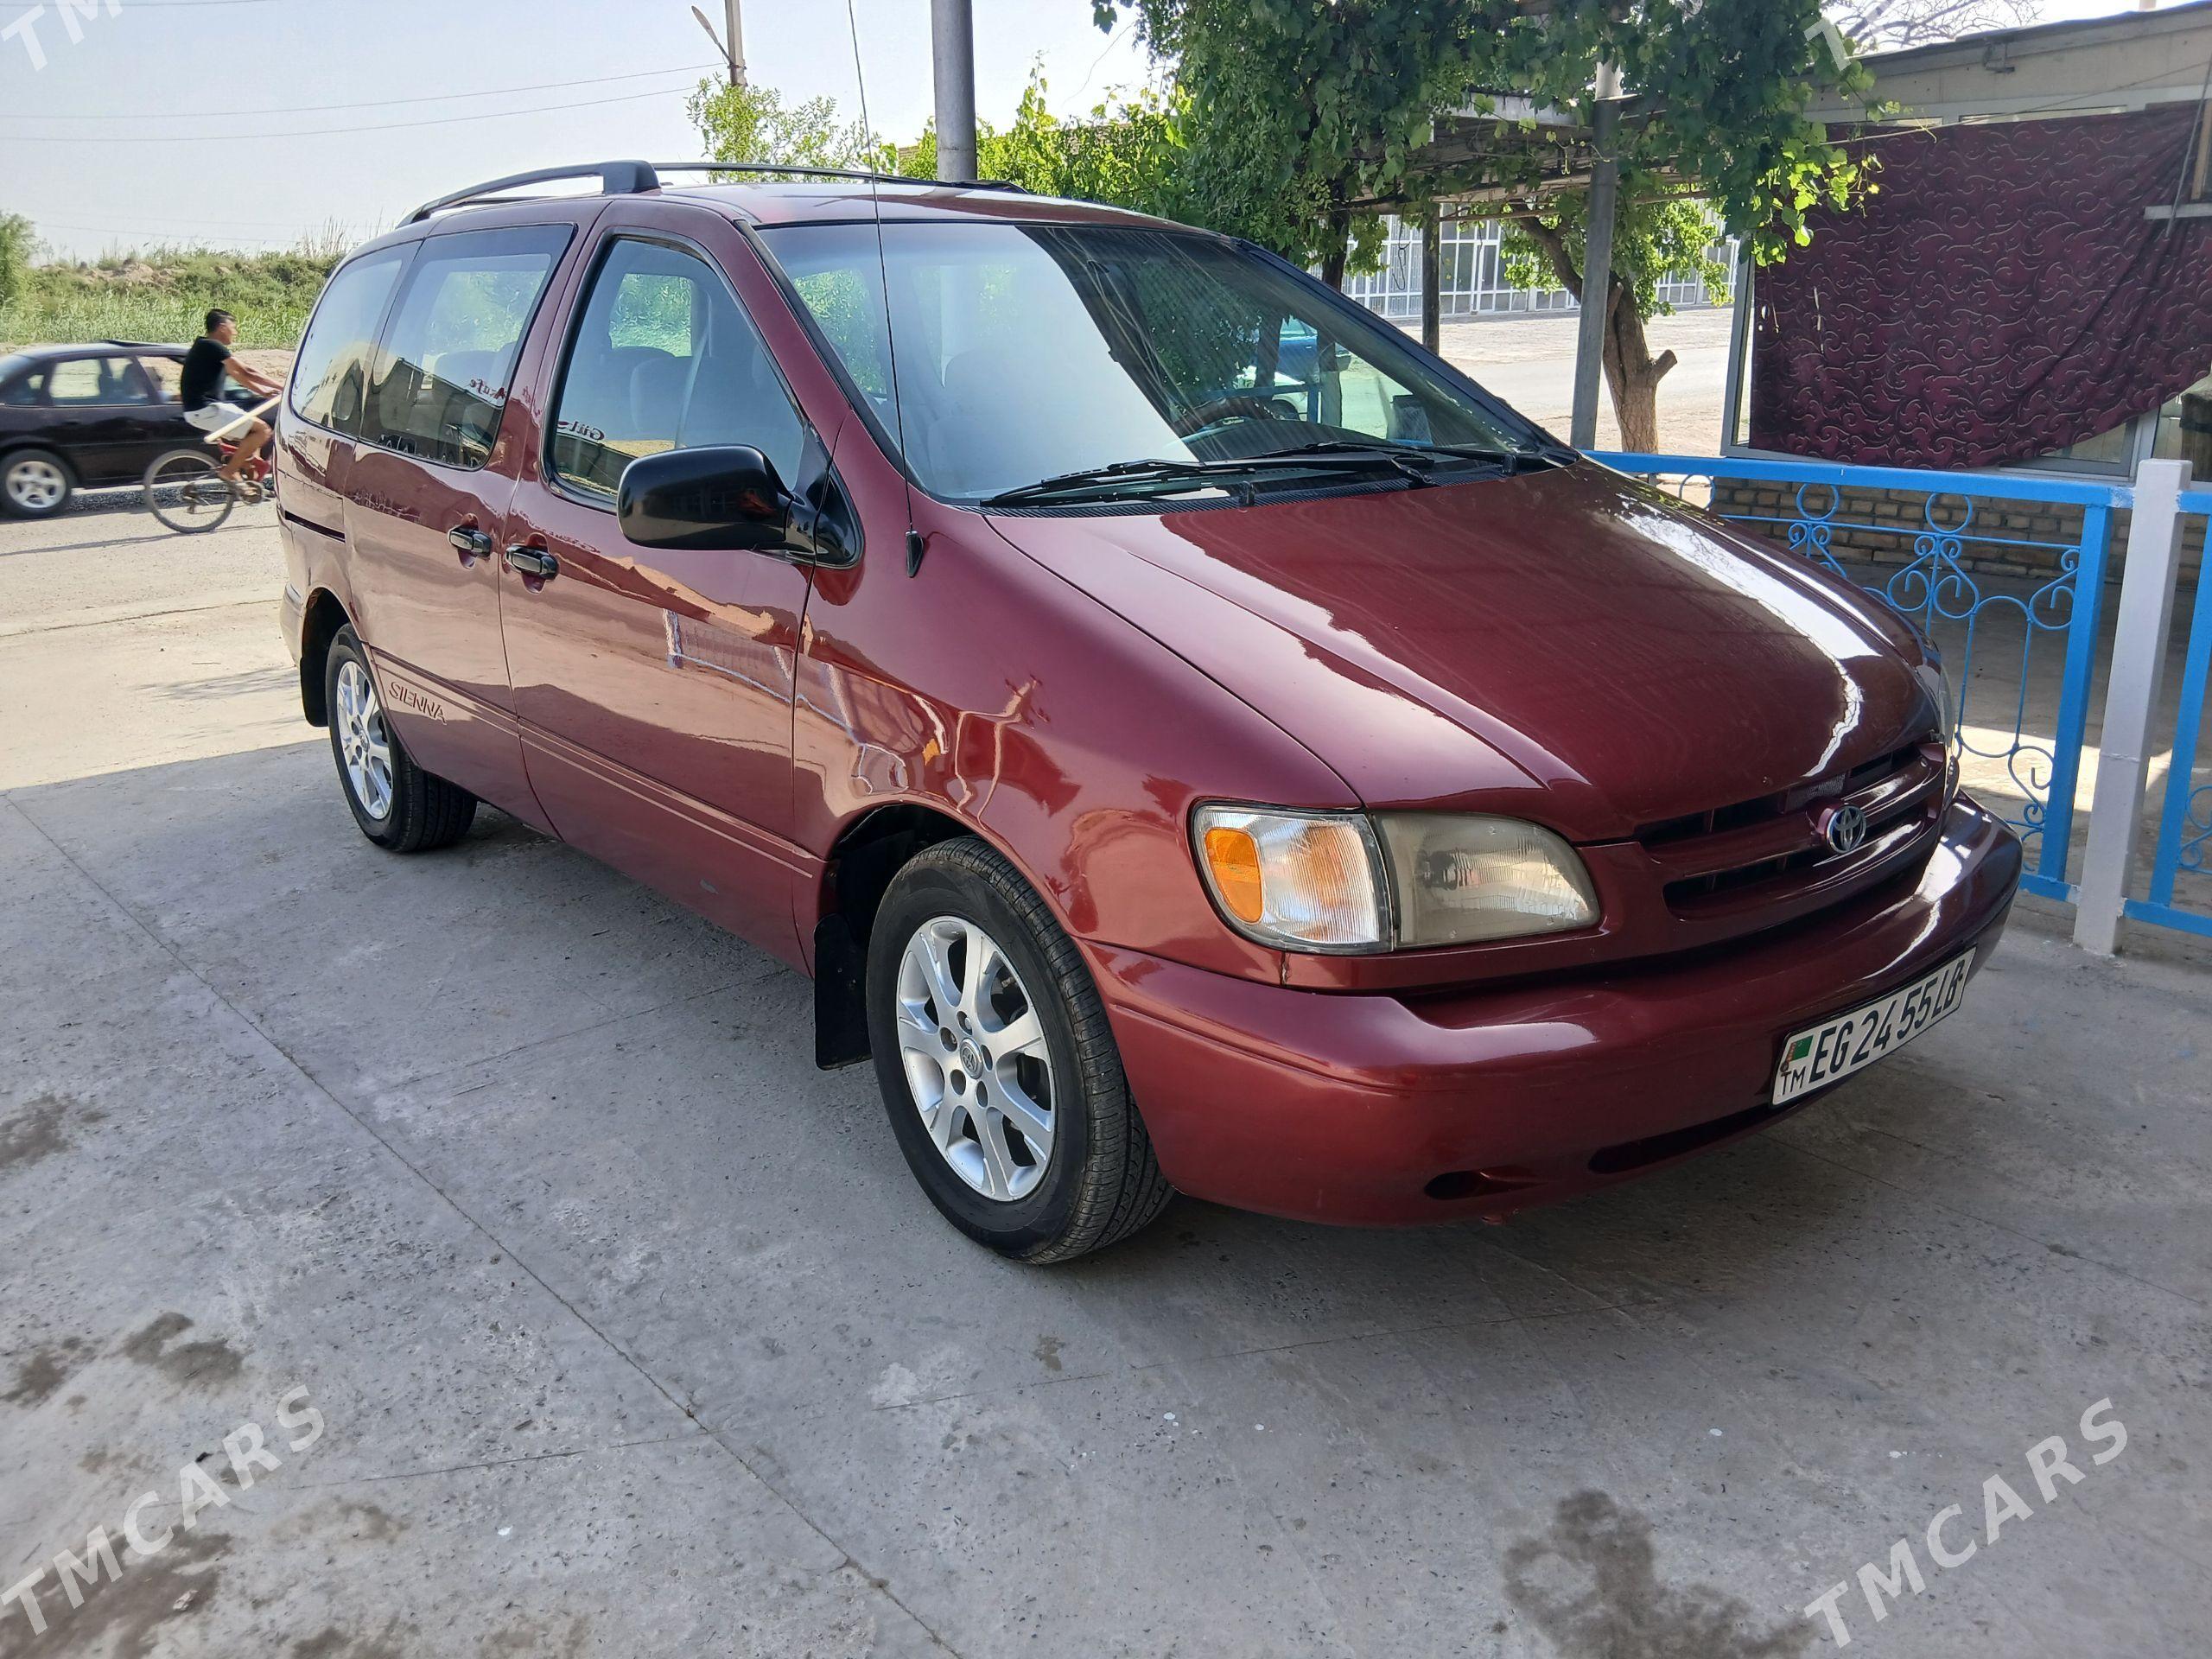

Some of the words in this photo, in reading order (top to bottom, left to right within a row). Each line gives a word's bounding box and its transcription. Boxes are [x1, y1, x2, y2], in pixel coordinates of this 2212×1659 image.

[389, 681, 448, 725] SIENNA
[1808, 1020, 1854, 1084] EG
[1850, 999, 1897, 1066] 24
[1897, 976, 1938, 1039] 55
[1780, 1065, 1807, 1096] TM
